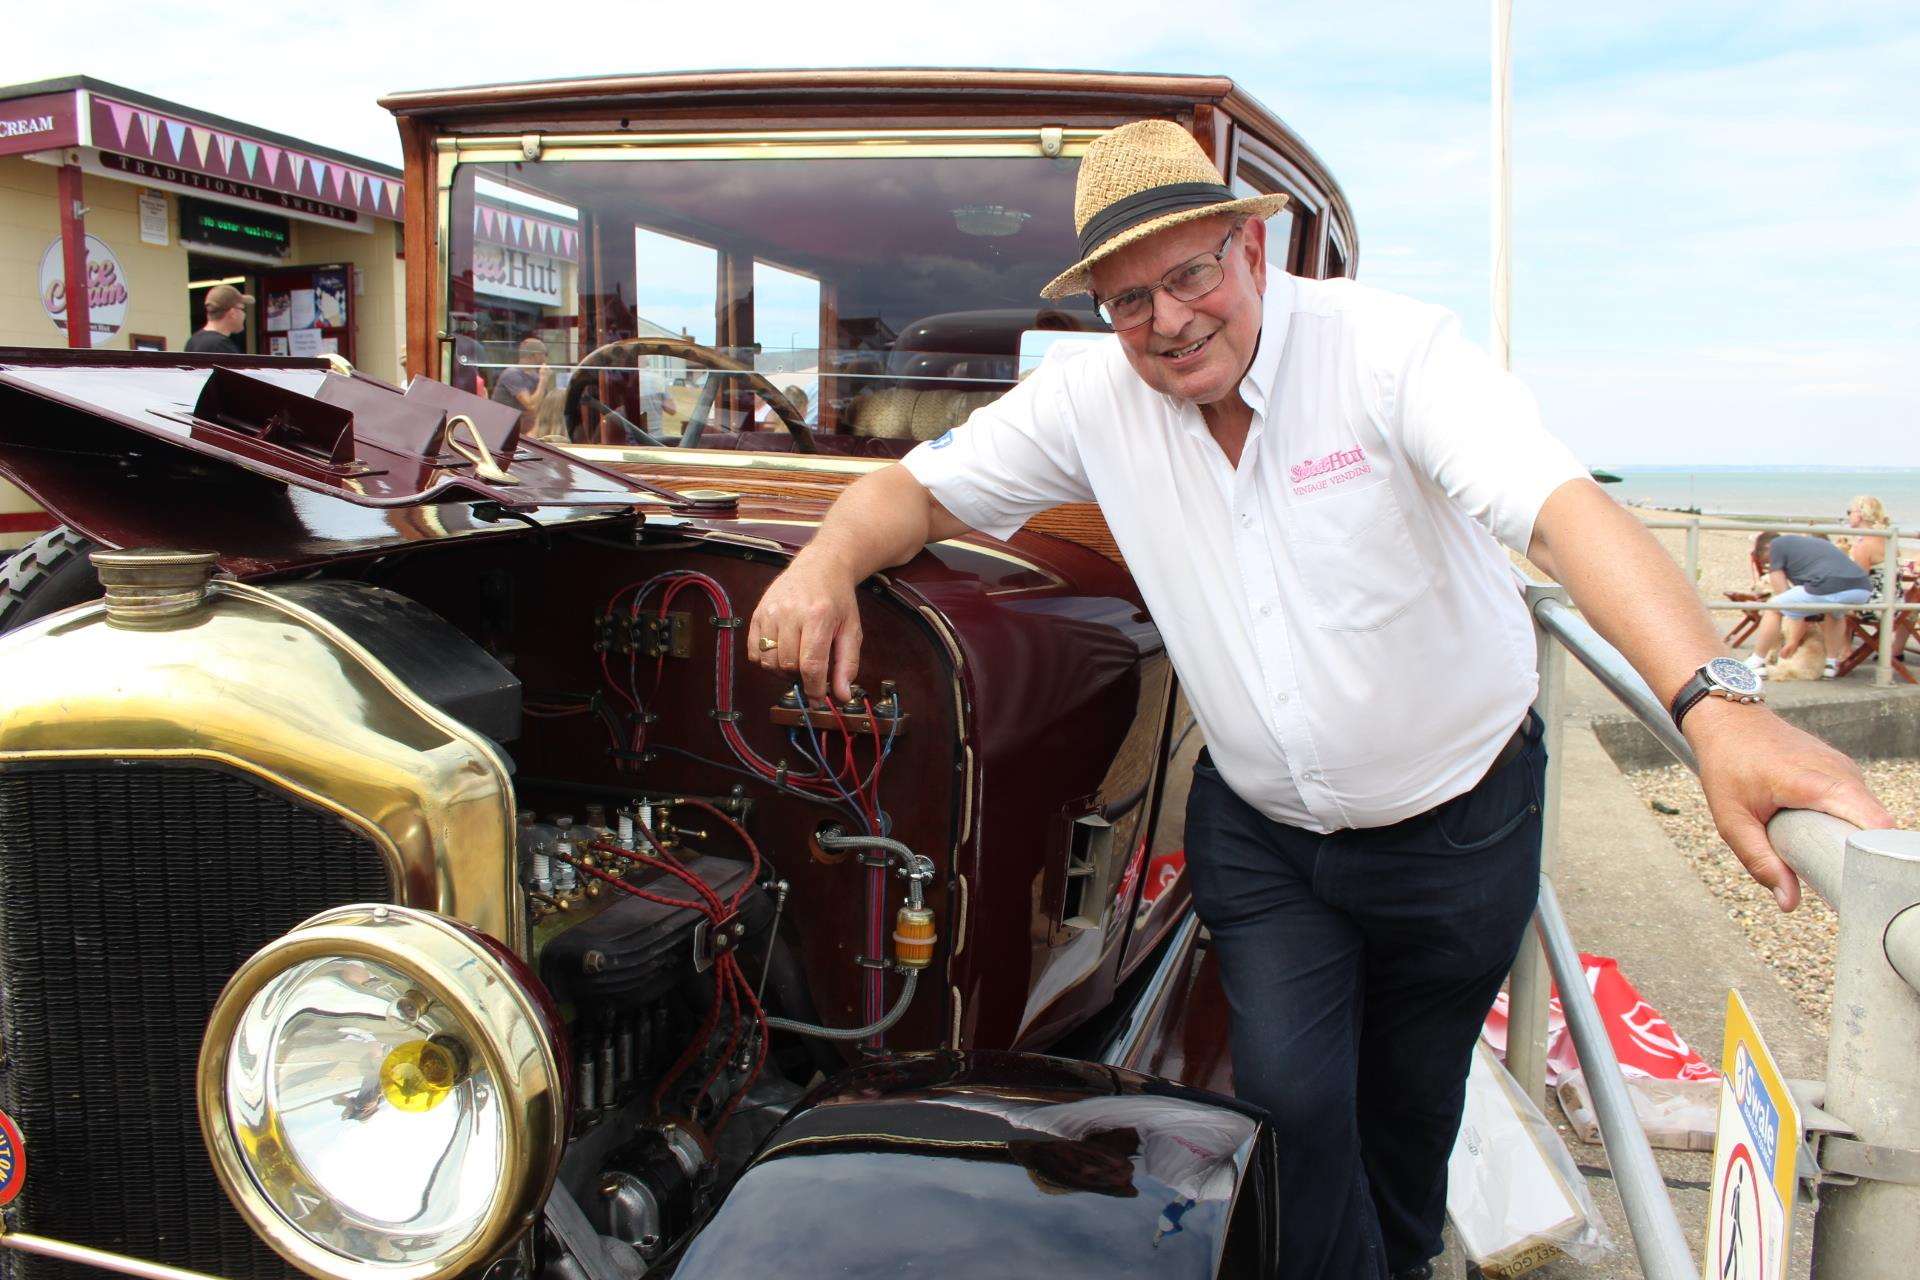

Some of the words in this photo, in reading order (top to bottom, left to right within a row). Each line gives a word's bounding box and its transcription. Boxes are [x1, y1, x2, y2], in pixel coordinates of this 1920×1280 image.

[0, 116, 54, 137] CREAM
[119, 156, 263, 201] TRADITIONAL
[280, 192, 346, 220] SWEETS
[505, 248, 558, 295] Hut
[46, 280, 128, 314] Cam
[1293, 480, 1329, 496] VINTAGE
[1746, 1065, 1775, 1156] Swale
